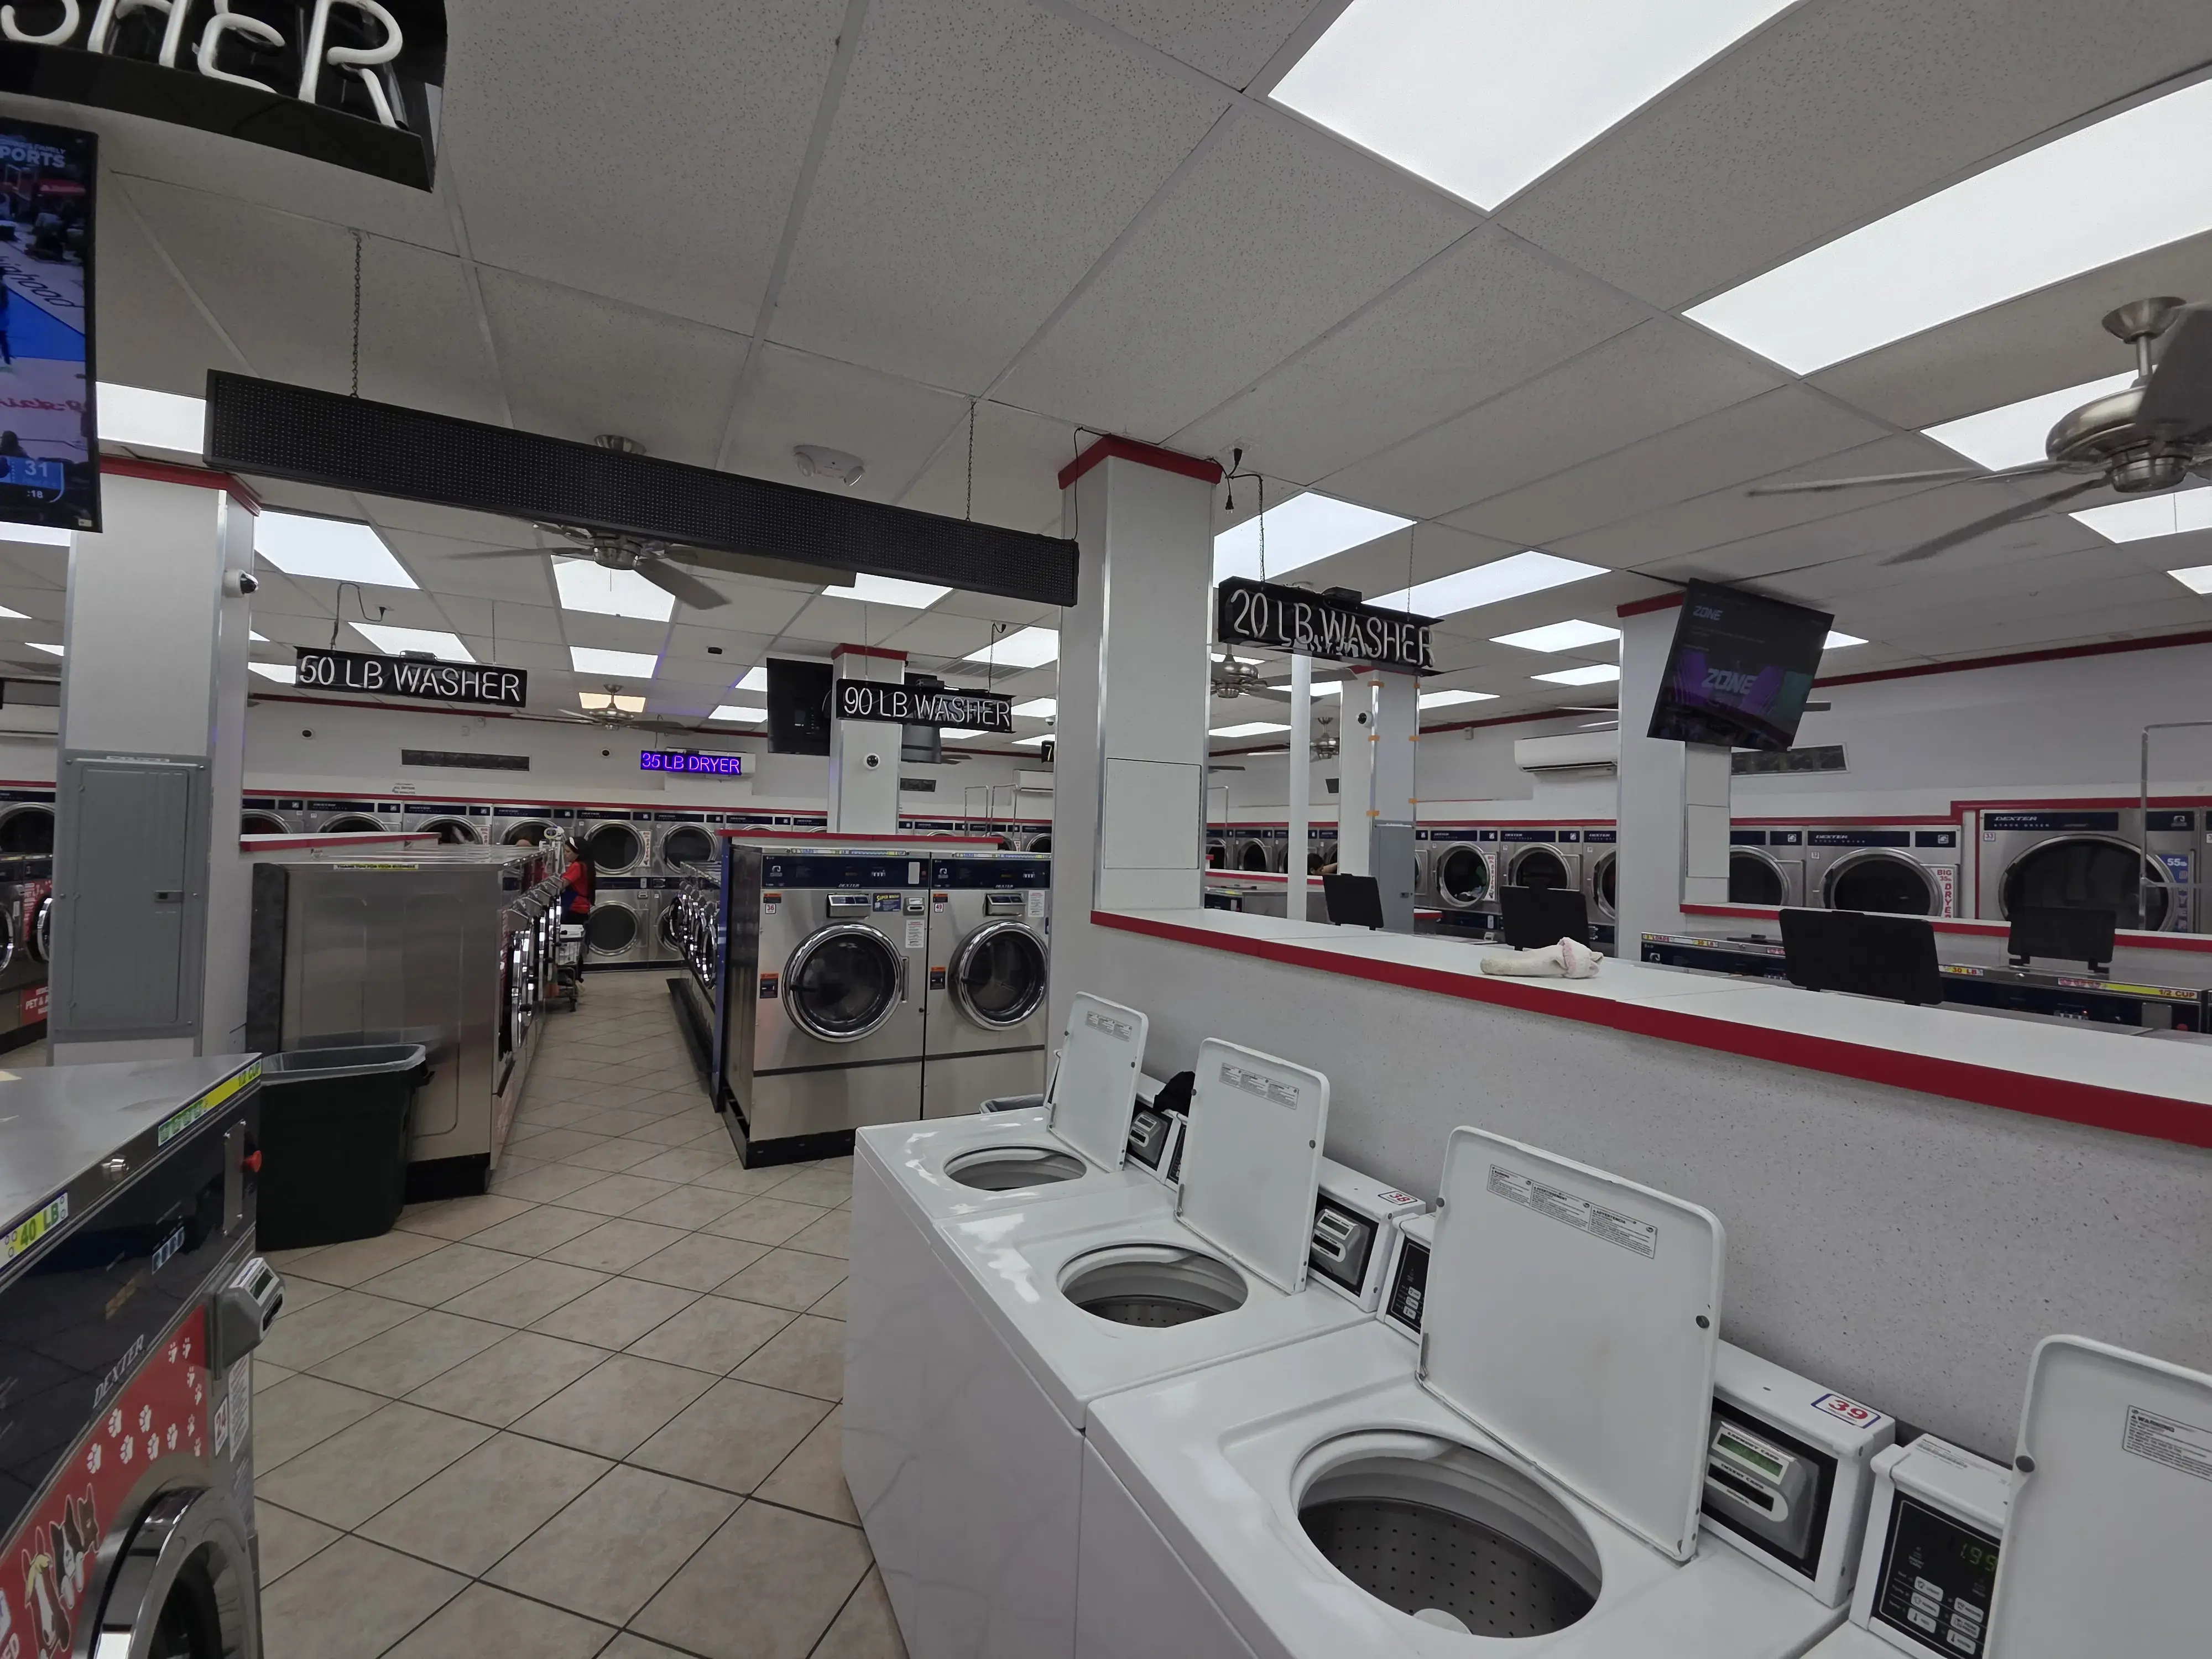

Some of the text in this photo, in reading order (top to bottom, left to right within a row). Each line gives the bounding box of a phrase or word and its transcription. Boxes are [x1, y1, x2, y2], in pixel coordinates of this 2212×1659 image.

[25, 460, 48, 477] 31
[1692, 605, 1723, 622] ZONE
[1231, 589, 1436, 667] 20 LB WASHER
[299, 655, 520, 702] 50 LB WASHER
[1701, 667, 1759, 695] ZONE
[844, 686, 1010, 727] 90 LB WASHER
[643, 752, 740, 774] 35 LB DRYER
[2174, 990, 2195, 998] CUP
[1389, 1193, 1411, 1203] 38
[20, 1202, 59, 1245] 40 LB
[93, 1333, 144, 1409] DEXTER
[216, 1402, 227, 1438] 24
[1828, 1399, 1869, 1420] 39
